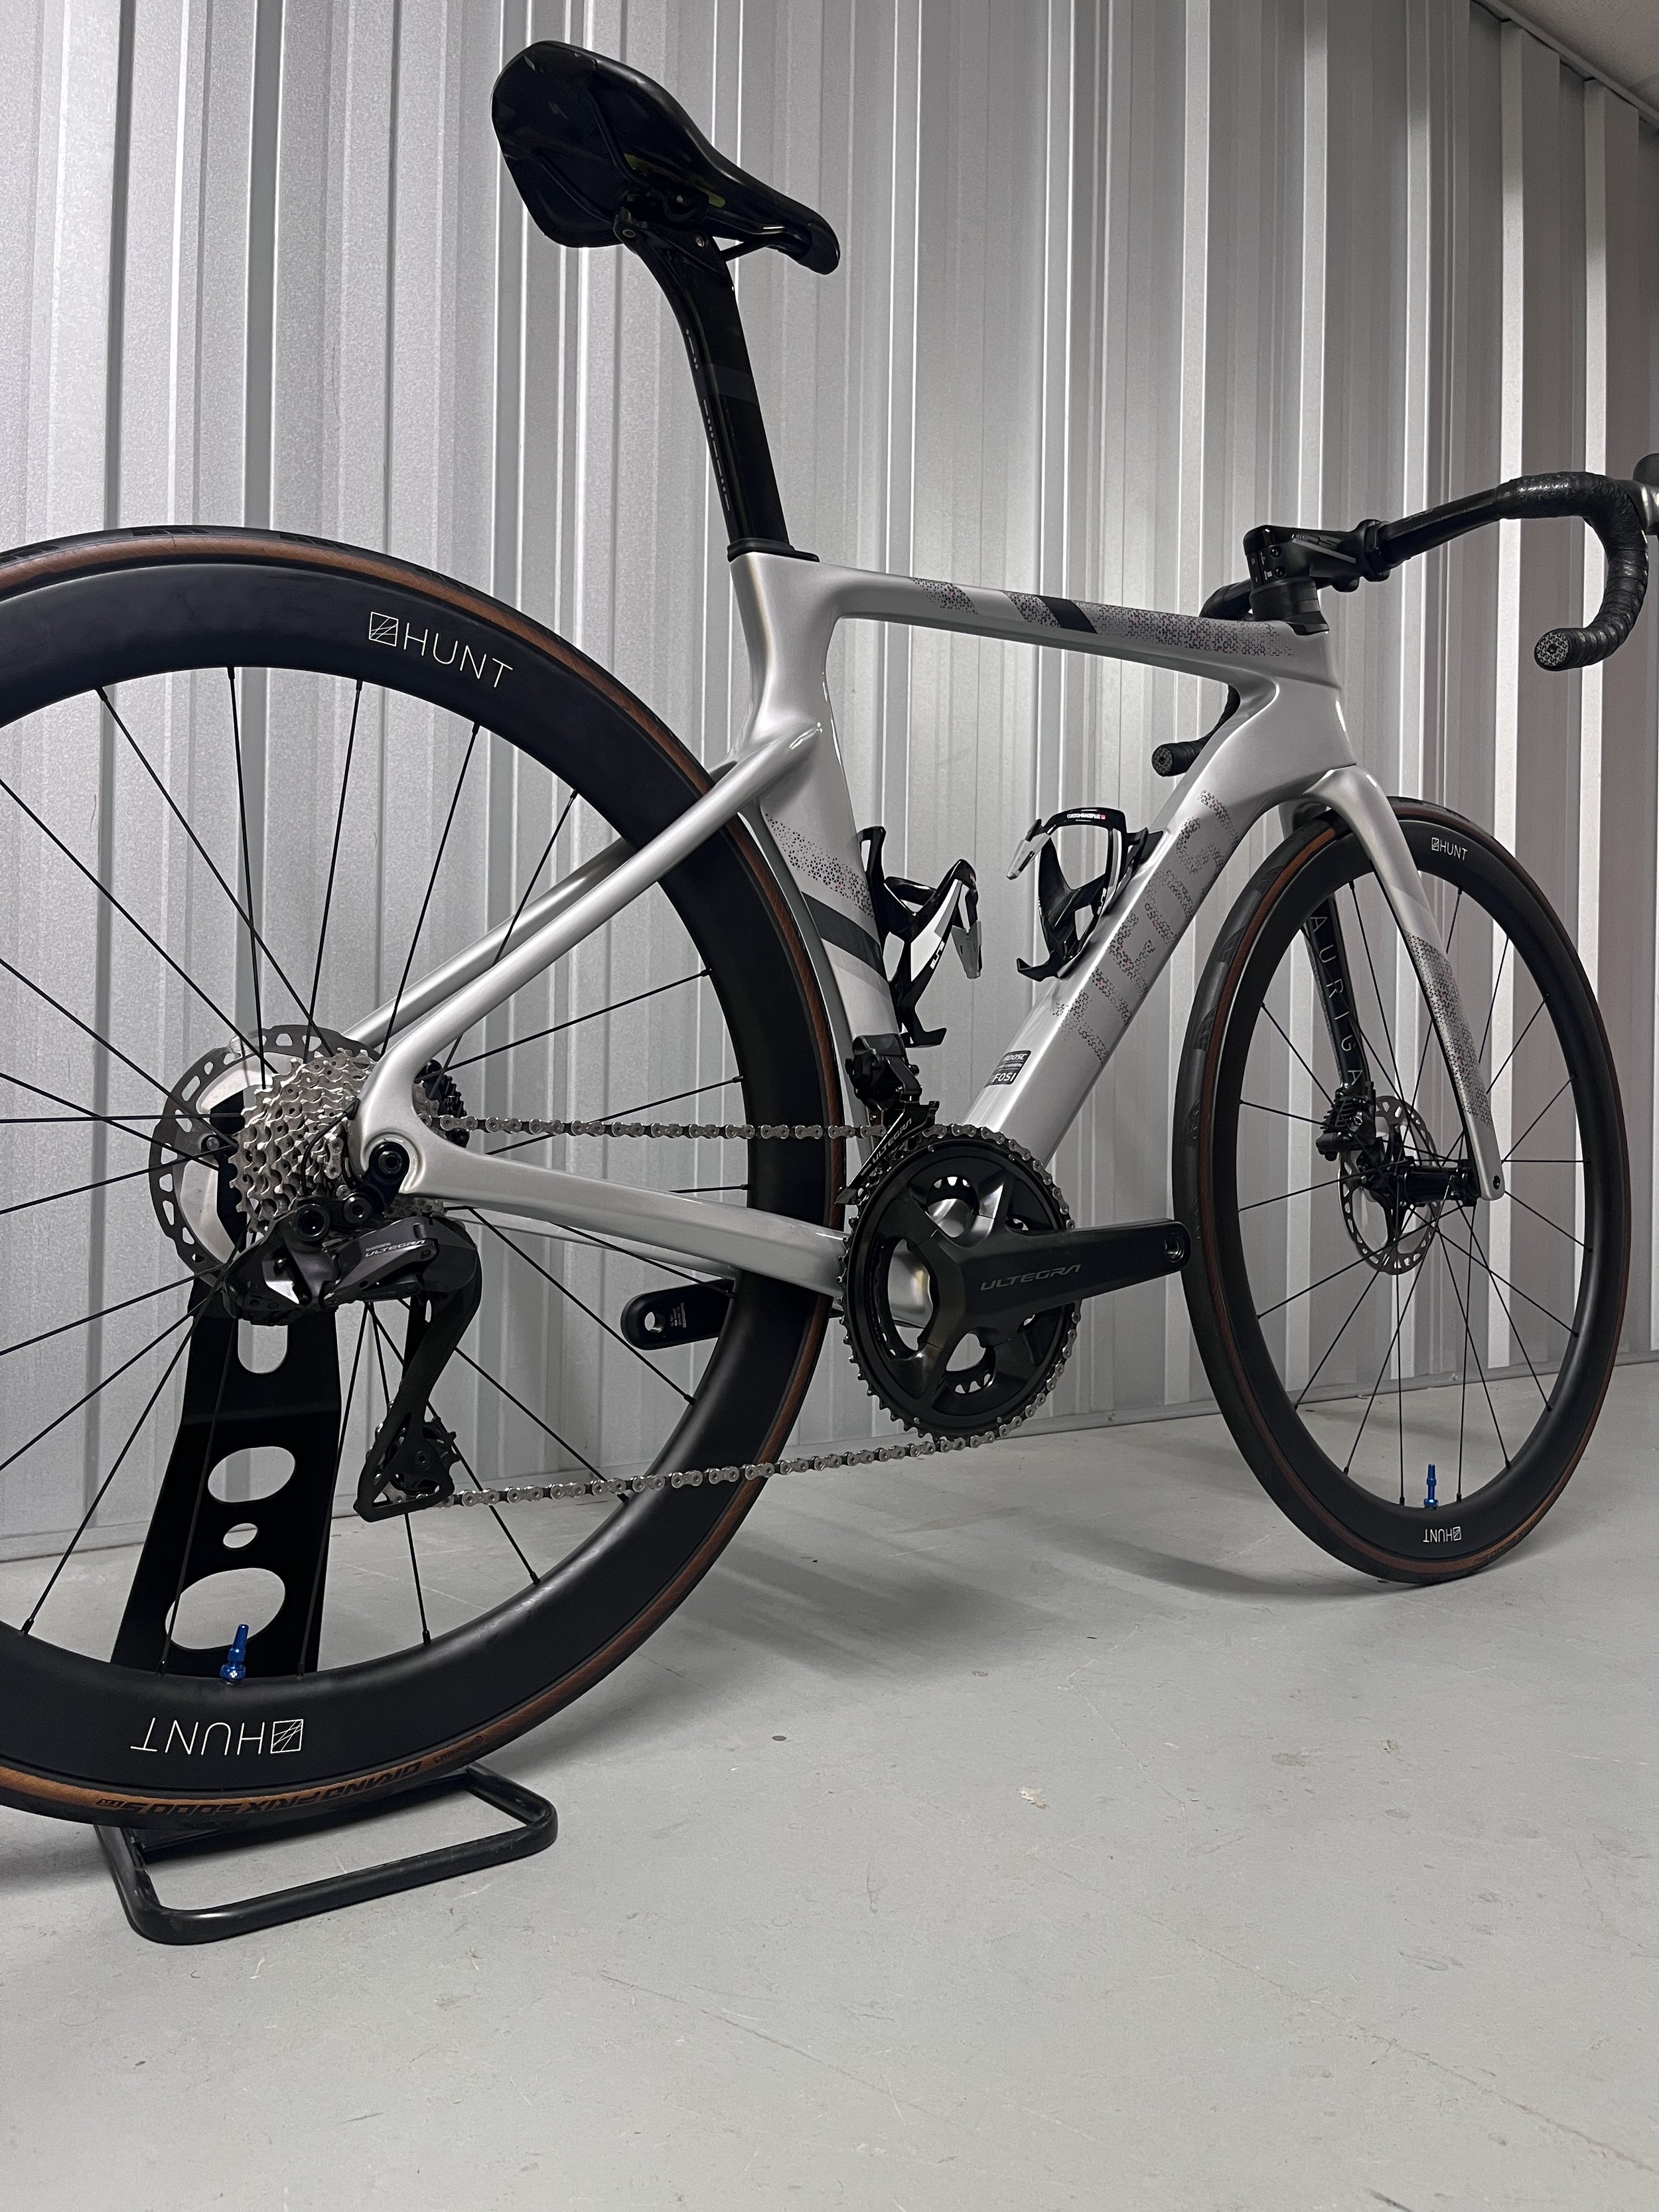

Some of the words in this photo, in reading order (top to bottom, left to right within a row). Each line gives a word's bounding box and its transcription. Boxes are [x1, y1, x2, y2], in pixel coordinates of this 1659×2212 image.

[403, 622, 514, 688] HUNT
[1439, 839, 1469, 861] HUNT
[1310, 916, 1364, 1086] AURIGA
[871, 1118, 912, 1164] ULTEGRA
[365, 1239, 426, 1258] ULTEGRA
[979, 1264, 1082, 1291] ULTEGRA
[1422, 1528, 1453, 1543] HUNT
[130, 1717, 265, 1756] HUNT
